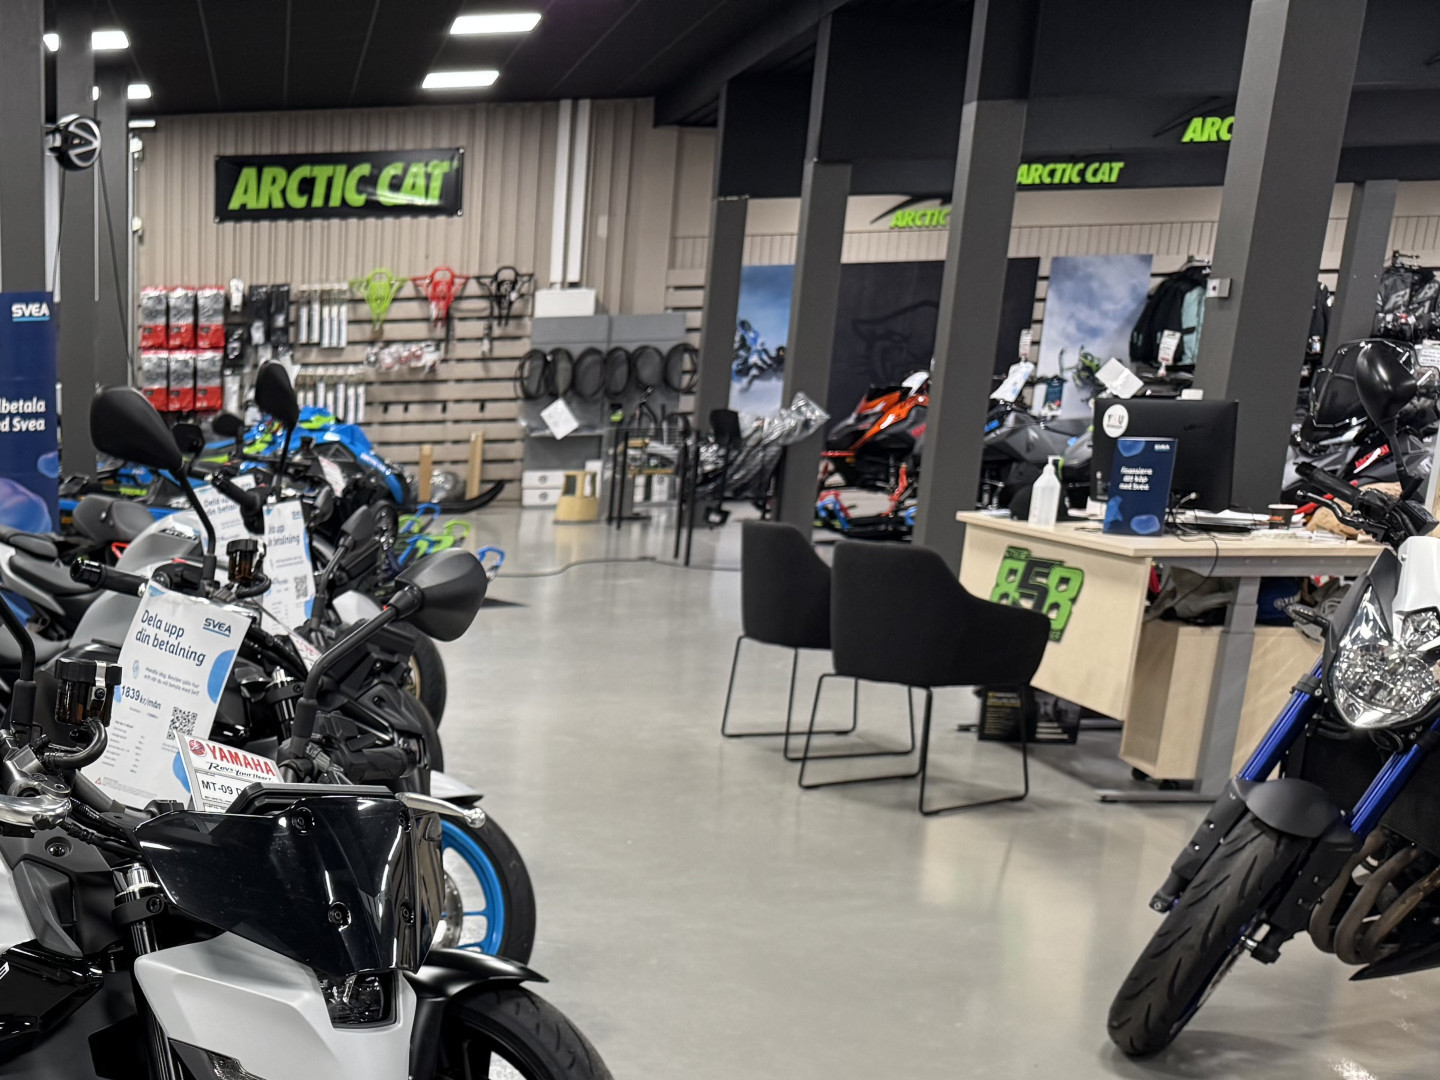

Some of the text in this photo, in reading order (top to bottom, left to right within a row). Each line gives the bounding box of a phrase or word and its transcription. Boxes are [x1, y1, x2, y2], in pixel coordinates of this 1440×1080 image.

[1180, 116, 1235, 142] ARC
[1016, 161, 1125, 184] ARCTIC CAT
[228, 160, 451, 210] ARCTIC CAT
[889, 208, 950, 229] ARCTIC
[11, 302, 50, 318] SVEA
[12, 418, 46, 433] Svea
[991, 557, 1085, 631] 858
[141, 609, 185, 640] Dela upp
[203, 618, 232, 635] SVEA
[135, 628, 206, 667] din betalning
[121, 685, 162, 710] 1839 kr/mån
[206, 743, 276, 777] YAMAHA
[206, 761, 234, 773] Revs
[201, 780, 233, 795] MT-09
